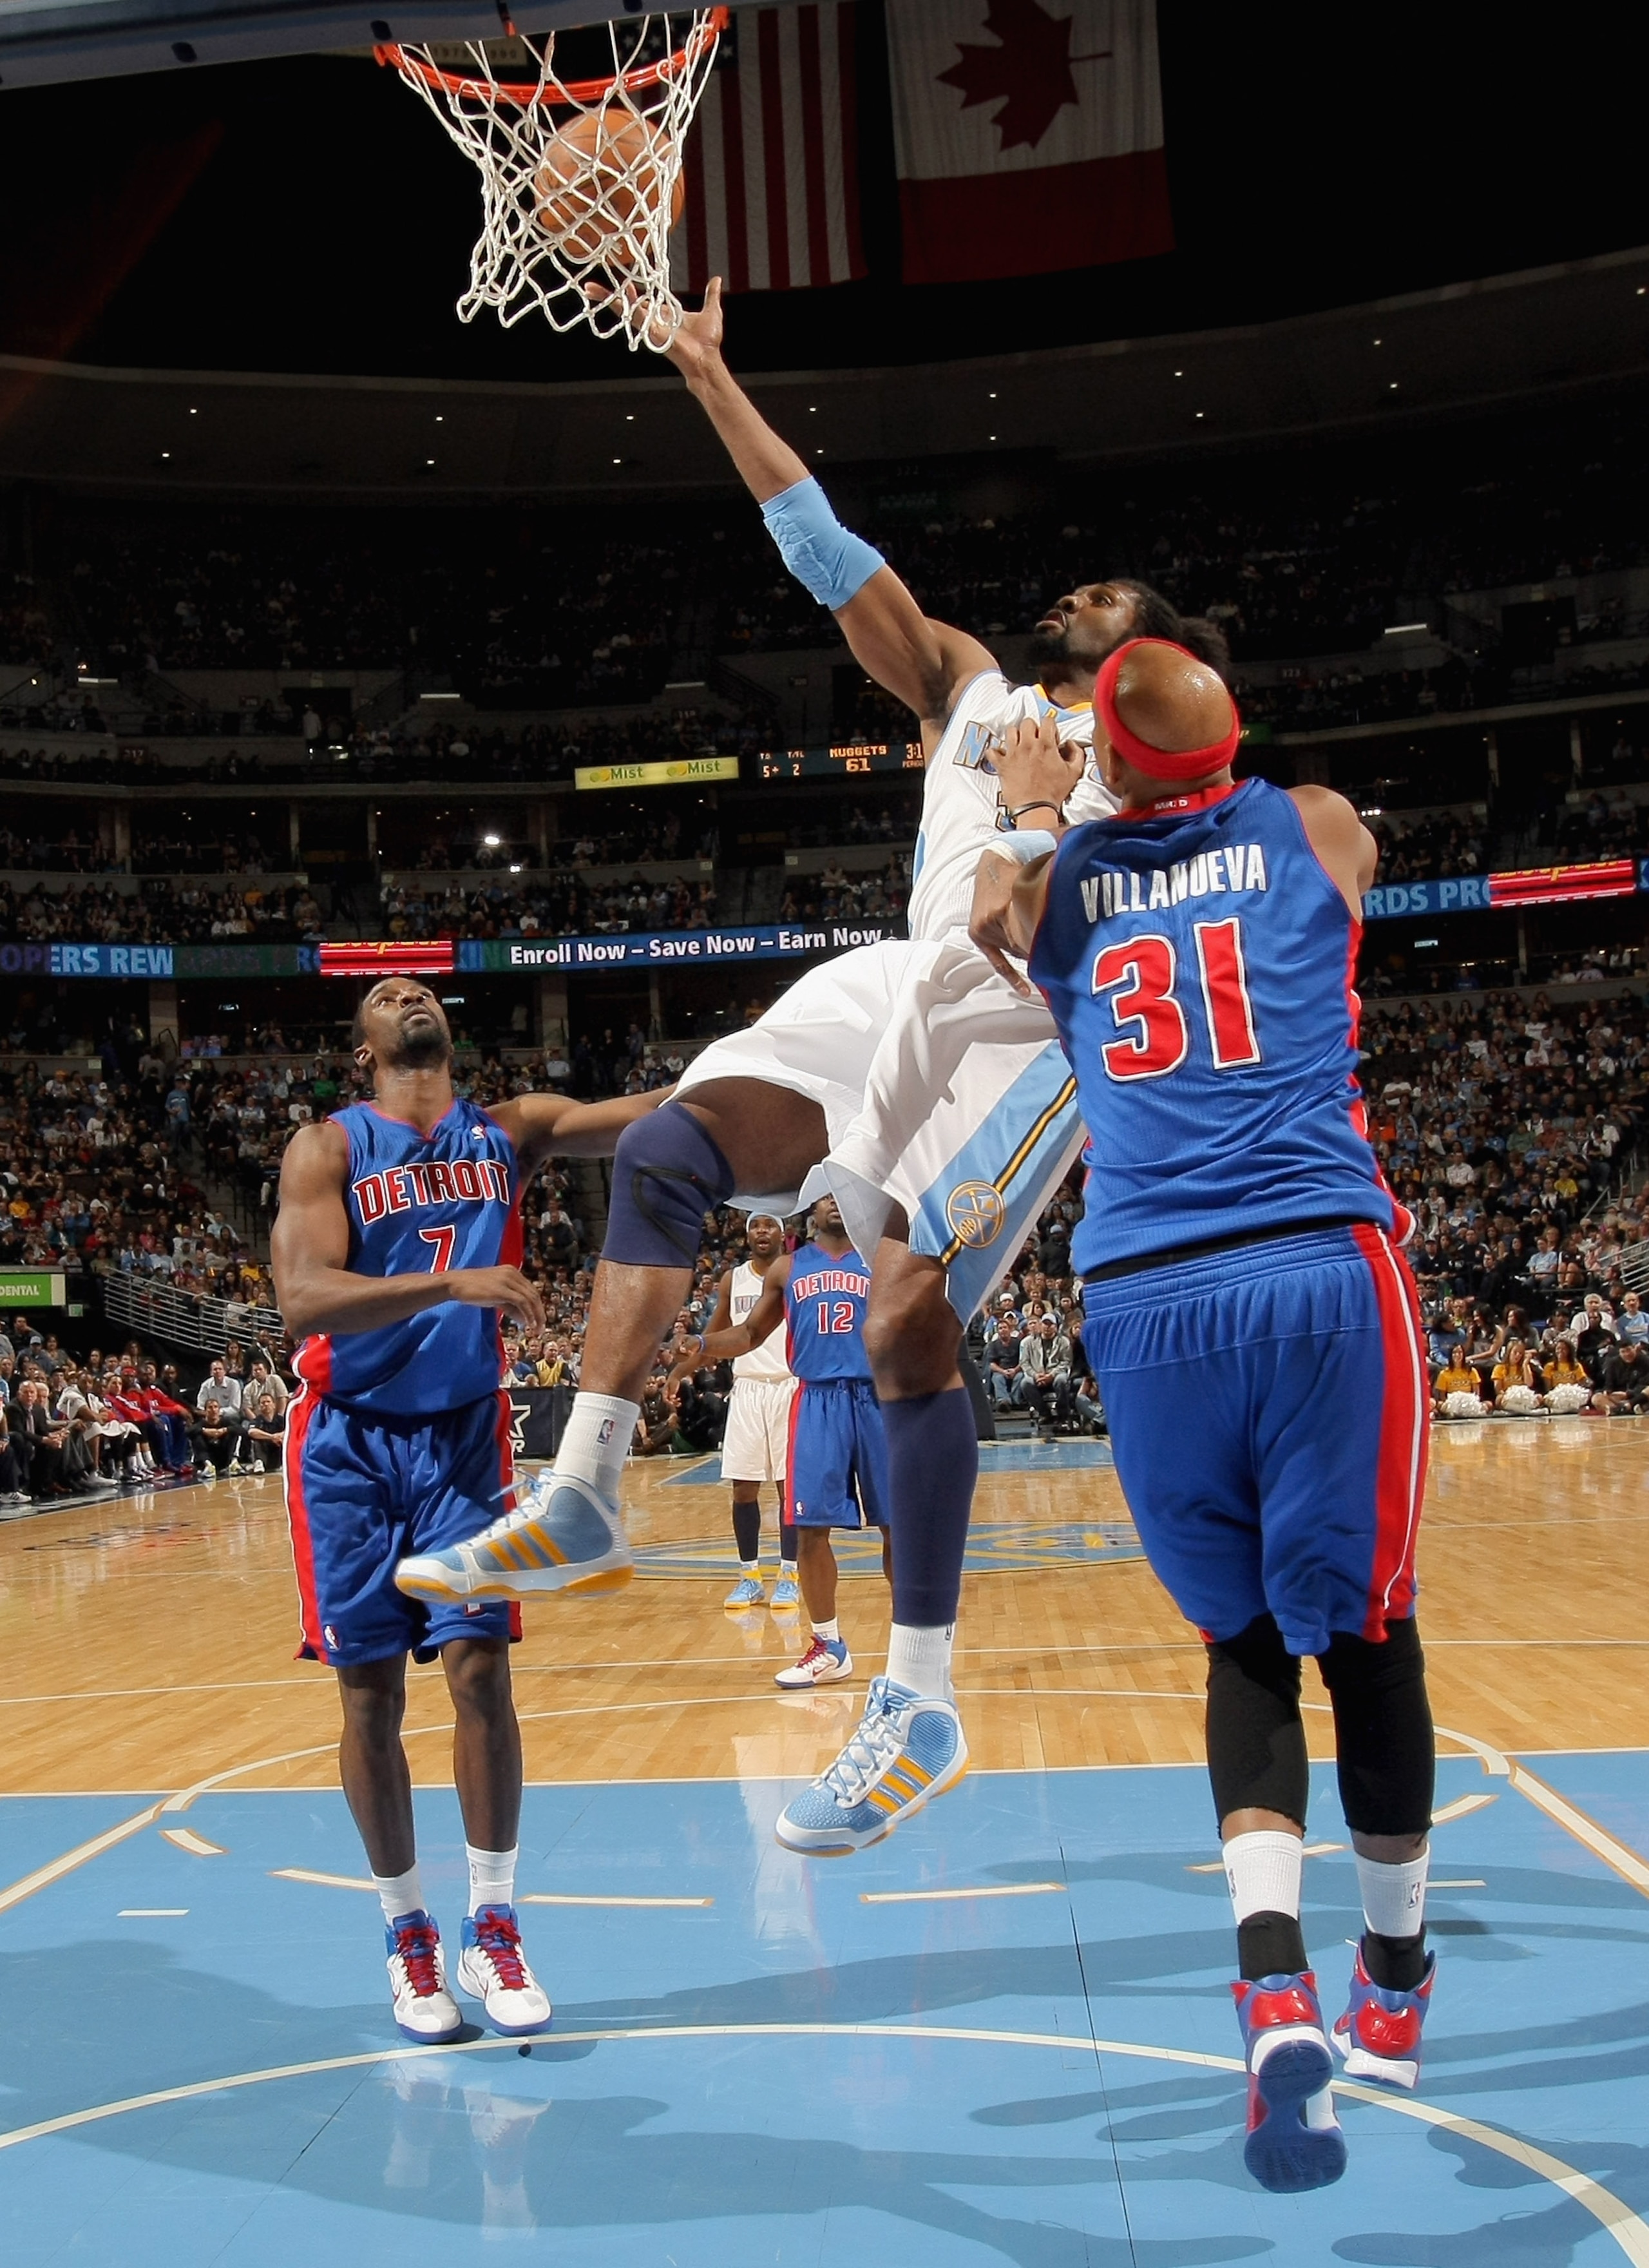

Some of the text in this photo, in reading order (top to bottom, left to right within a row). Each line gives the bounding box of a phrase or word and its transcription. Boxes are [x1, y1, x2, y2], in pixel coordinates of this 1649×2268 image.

[687, 760, 721, 774] Mist
[830, 745, 887, 758] NUGGETS
[846, 758, 871, 772] 61
[611, 766, 643, 780] Mist
[793, 764, 800, 776] 2
[1080, 844, 1266, 923] VILLANUEVA
[510, 944, 571, 964] Enroll
[578, 943, 625, 962] Now
[649, 939, 700, 957] Save
[707, 935, 755, 954] Now
[779, 930, 826, 950] Earn
[833, 928, 882, 947] Now
[1092, 917, 1261, 1082] 31
[352, 1159, 511, 1225] DETROIT
[419, 1224, 455, 1274] 7
[818, 1302, 854, 1334] 12
